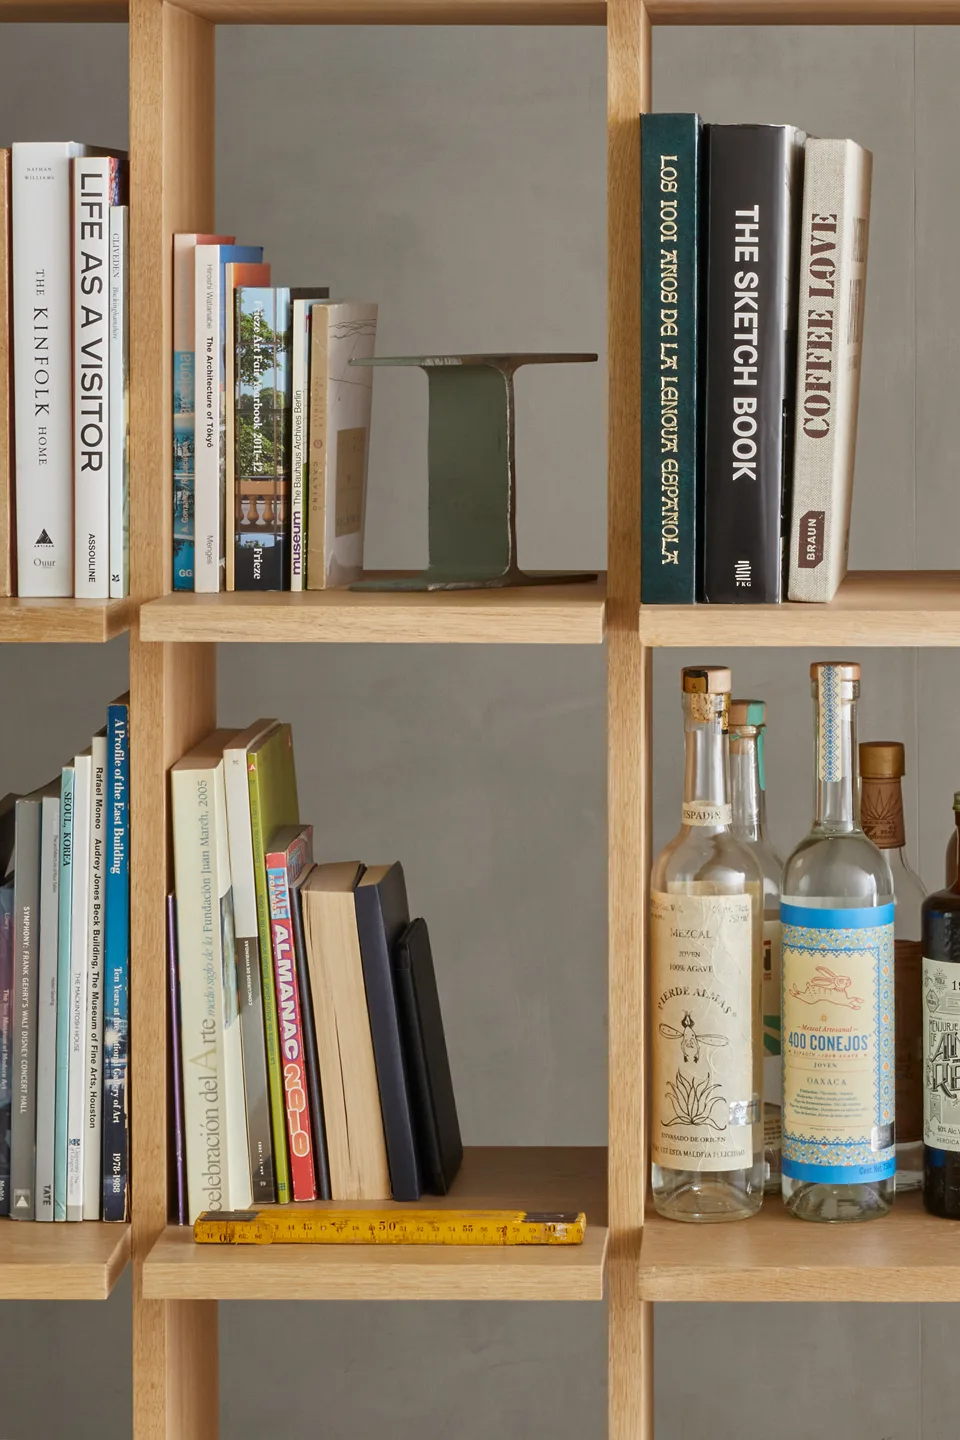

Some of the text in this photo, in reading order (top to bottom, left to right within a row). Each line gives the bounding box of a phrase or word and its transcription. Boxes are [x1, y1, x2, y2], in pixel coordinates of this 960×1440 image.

[660, 154, 678, 192] LOS
[660, 250, 678, 303] AÑOS
[660, 308, 678, 335] DE
[732, 204, 759, 480] THE SKETCH BOOK
[802, 213, 838, 439] COFFEE LOVE
[32, 269, 49, 466] THE KINFOLK HOME
[80, 172, 102, 582] LIFE AS A VISITOR ASSOULINE
[253, 334, 262, 430] Art Yearbook
[660, 344, 678, 370] LA
[660, 376, 678, 453] LENGUA
[292, 390, 302, 575] museum The Bauhaus Archives Berlin
[660, 457, 678, 566] ESPAÑOLA
[204, 535, 214, 564] Menges
[254, 548, 262, 580] Frieze
[806, 517, 816, 560] BRAUN
[196, 780, 208, 807] 2005
[62, 792, 72, 867] SEOUL, KOREA
[89, 766, 103, 1128] Rafael Moneo Audrey Jones Beck Museum Houston
[670, 928, 713, 939] MEZCAL
[110, 730, 124, 1193] Profile East Building 1978-1988
[272, 922, 300, 1060] ALMANAC
[692, 988, 732, 1014] ALMAS
[788, 1032, 868, 1051] 400 CONEJOS
[806, 1077, 847, 1086] OAXACA
[196, 1074, 222, 1211] celebración del
[42, 1184, 51, 1206] TATE
[379, 1220, 396, 1232] 50
